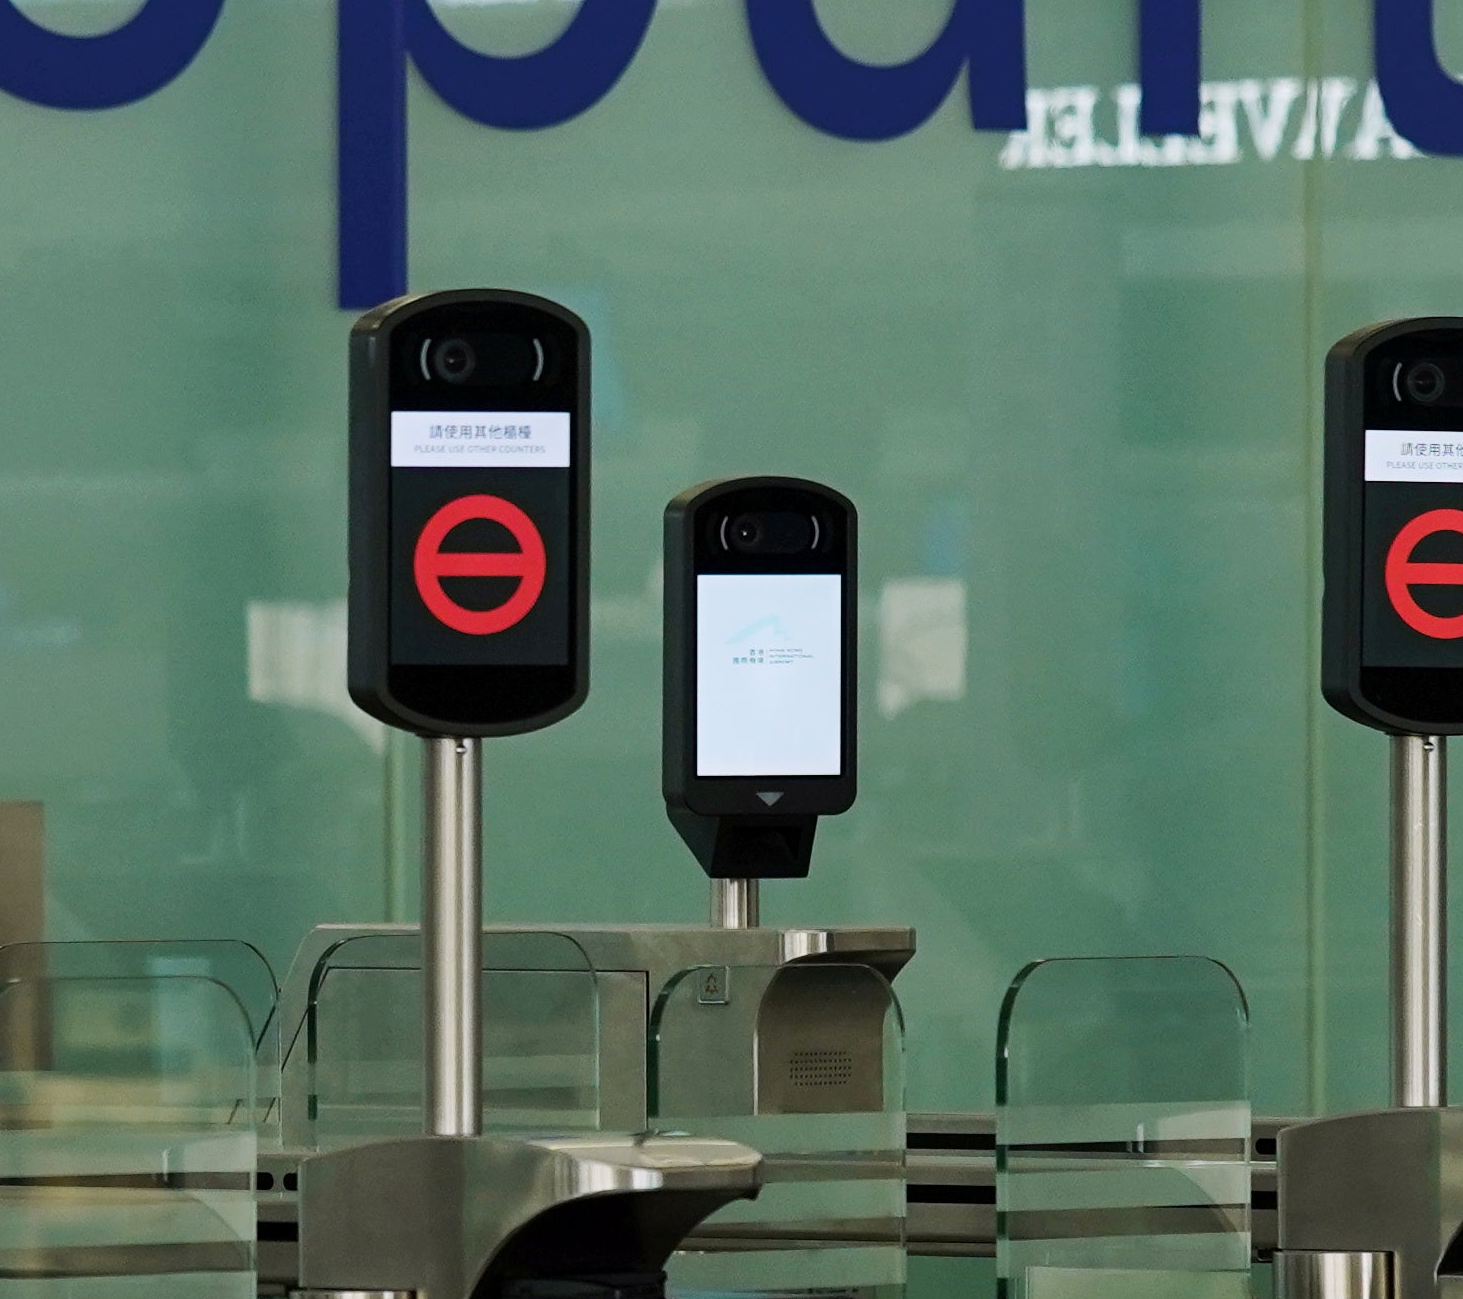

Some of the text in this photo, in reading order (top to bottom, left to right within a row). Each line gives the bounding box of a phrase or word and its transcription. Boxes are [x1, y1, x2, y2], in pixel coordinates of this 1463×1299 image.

[1386, 461, 1416, 469] PLEASE
[1419, 462, 1433, 470] USE
[1436, 462, 1463, 470] OTHER
